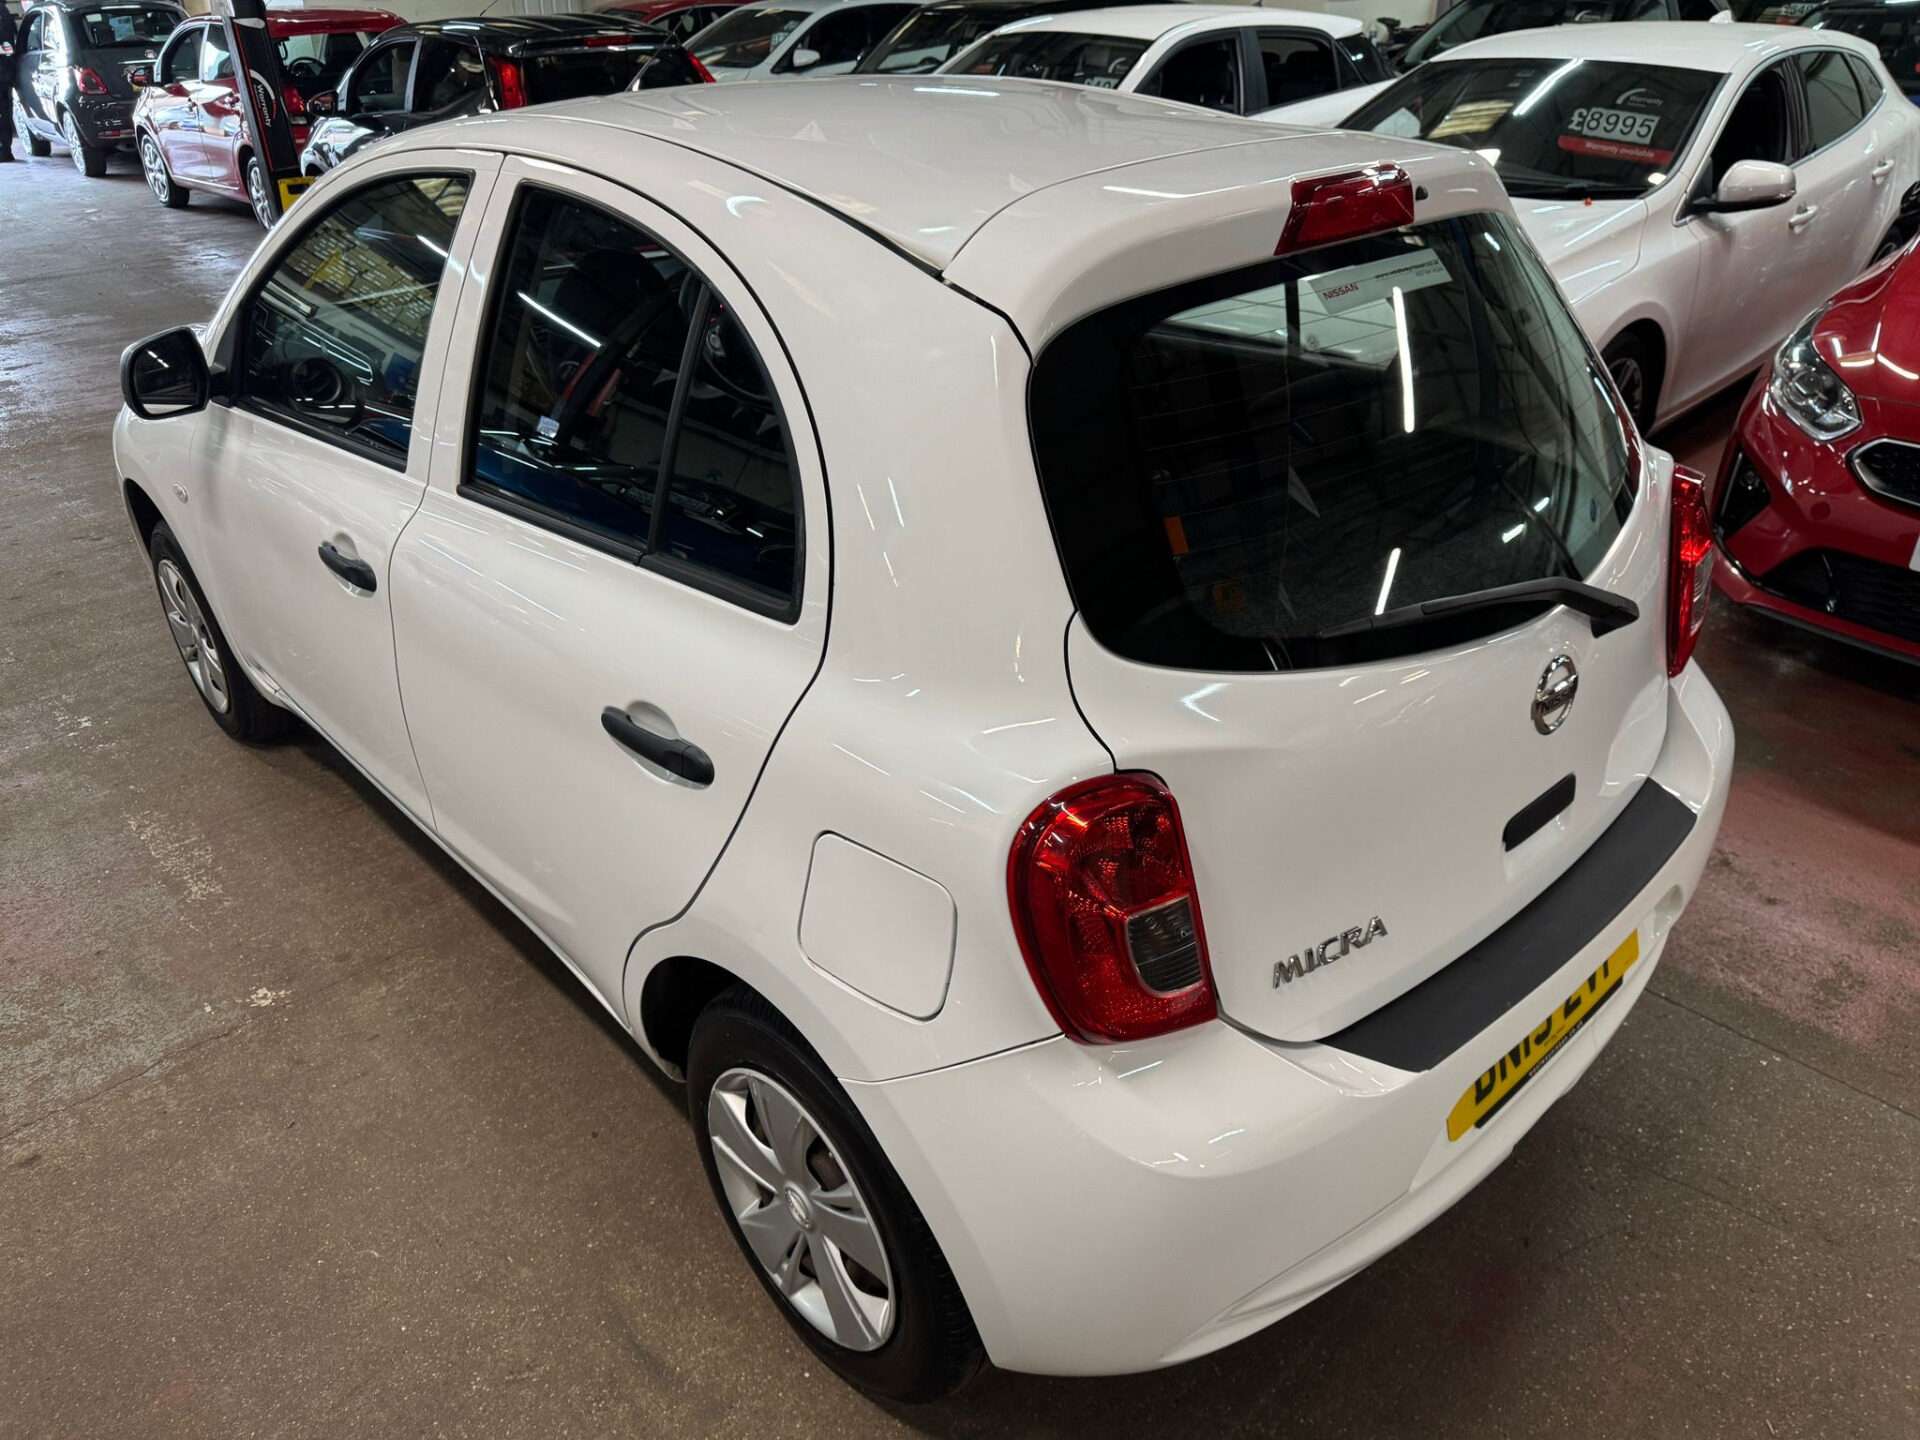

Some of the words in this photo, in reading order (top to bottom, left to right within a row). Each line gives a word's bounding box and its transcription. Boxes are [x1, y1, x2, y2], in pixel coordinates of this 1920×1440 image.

[1568, 107, 1655, 138] £8995
[1323, 283, 1359, 300] NISSAN
[1272, 916, 1388, 989] MICRA
